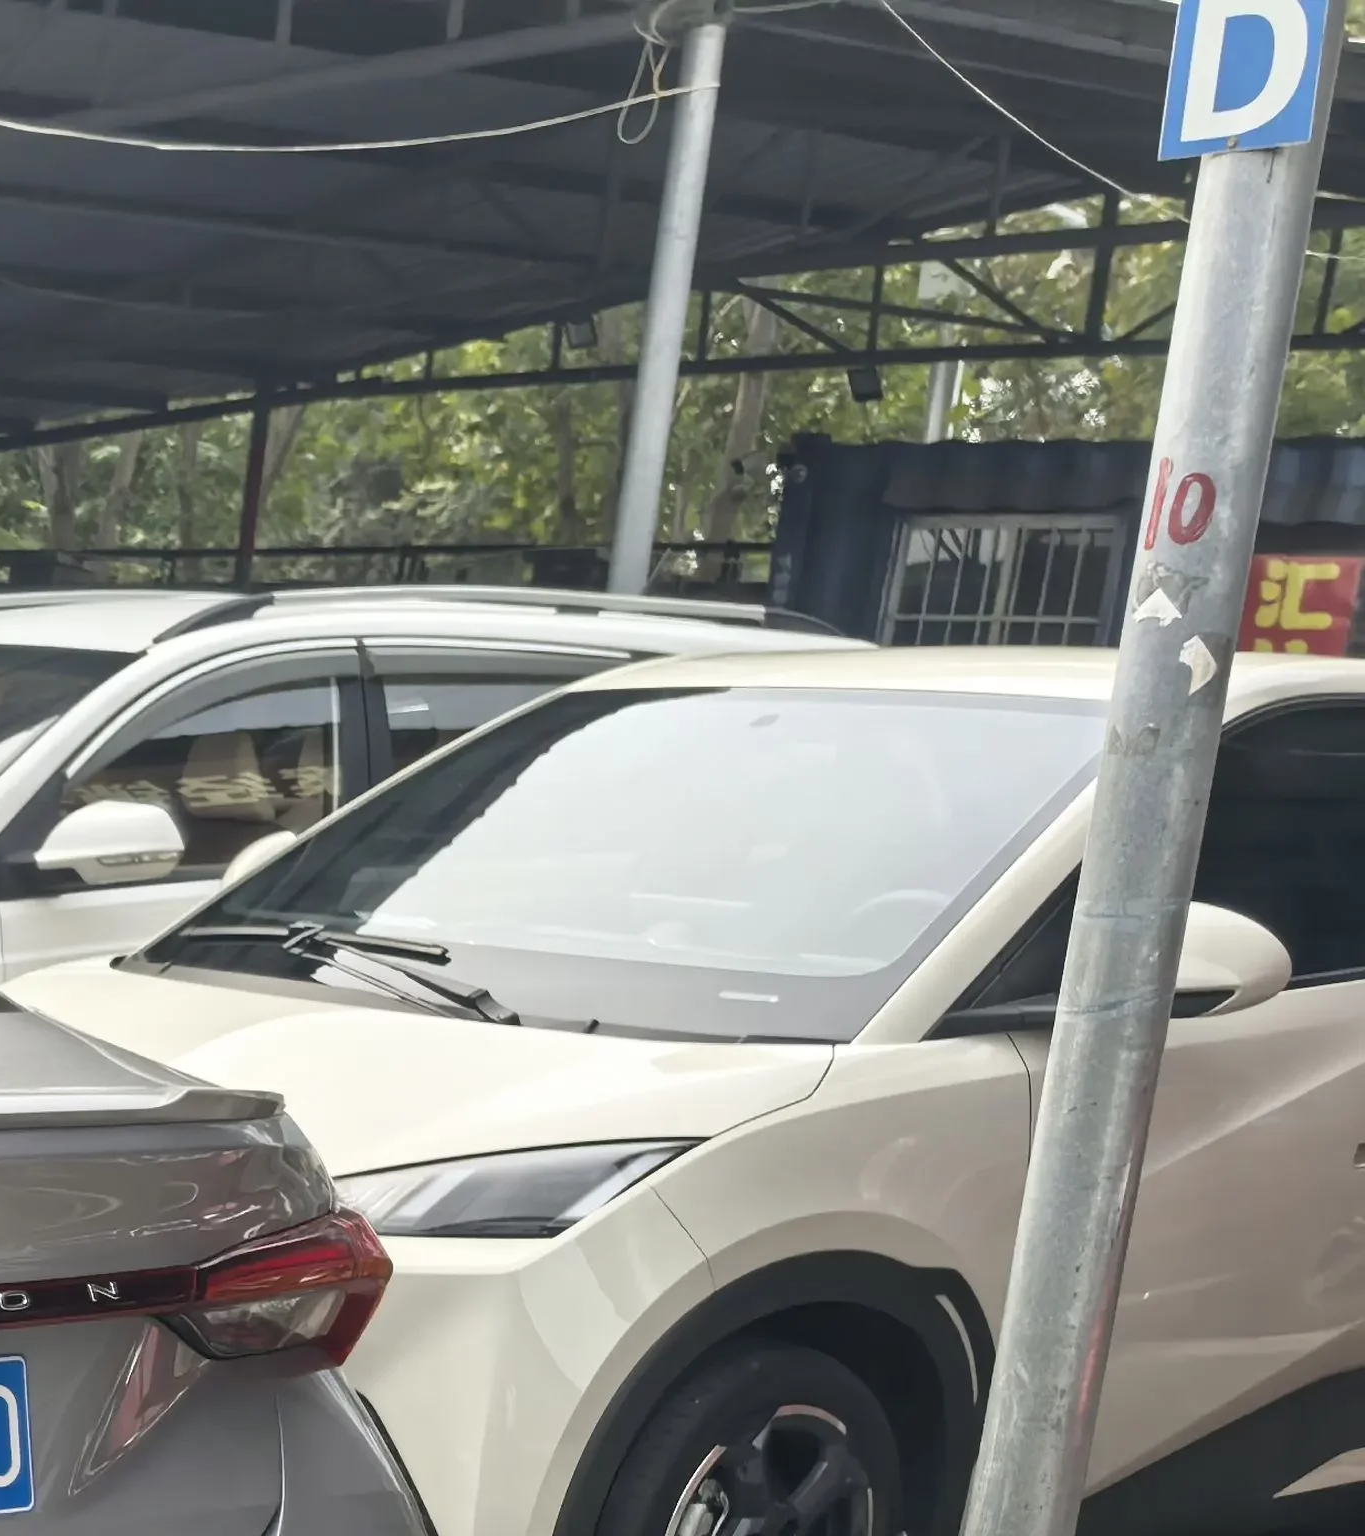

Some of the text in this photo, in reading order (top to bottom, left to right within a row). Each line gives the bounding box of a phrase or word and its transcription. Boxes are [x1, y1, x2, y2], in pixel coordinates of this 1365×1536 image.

[1180, 0, 1308, 142] D
[1144, 457, 1216, 551] 10
[1255, 558, 1341, 631] 汇
